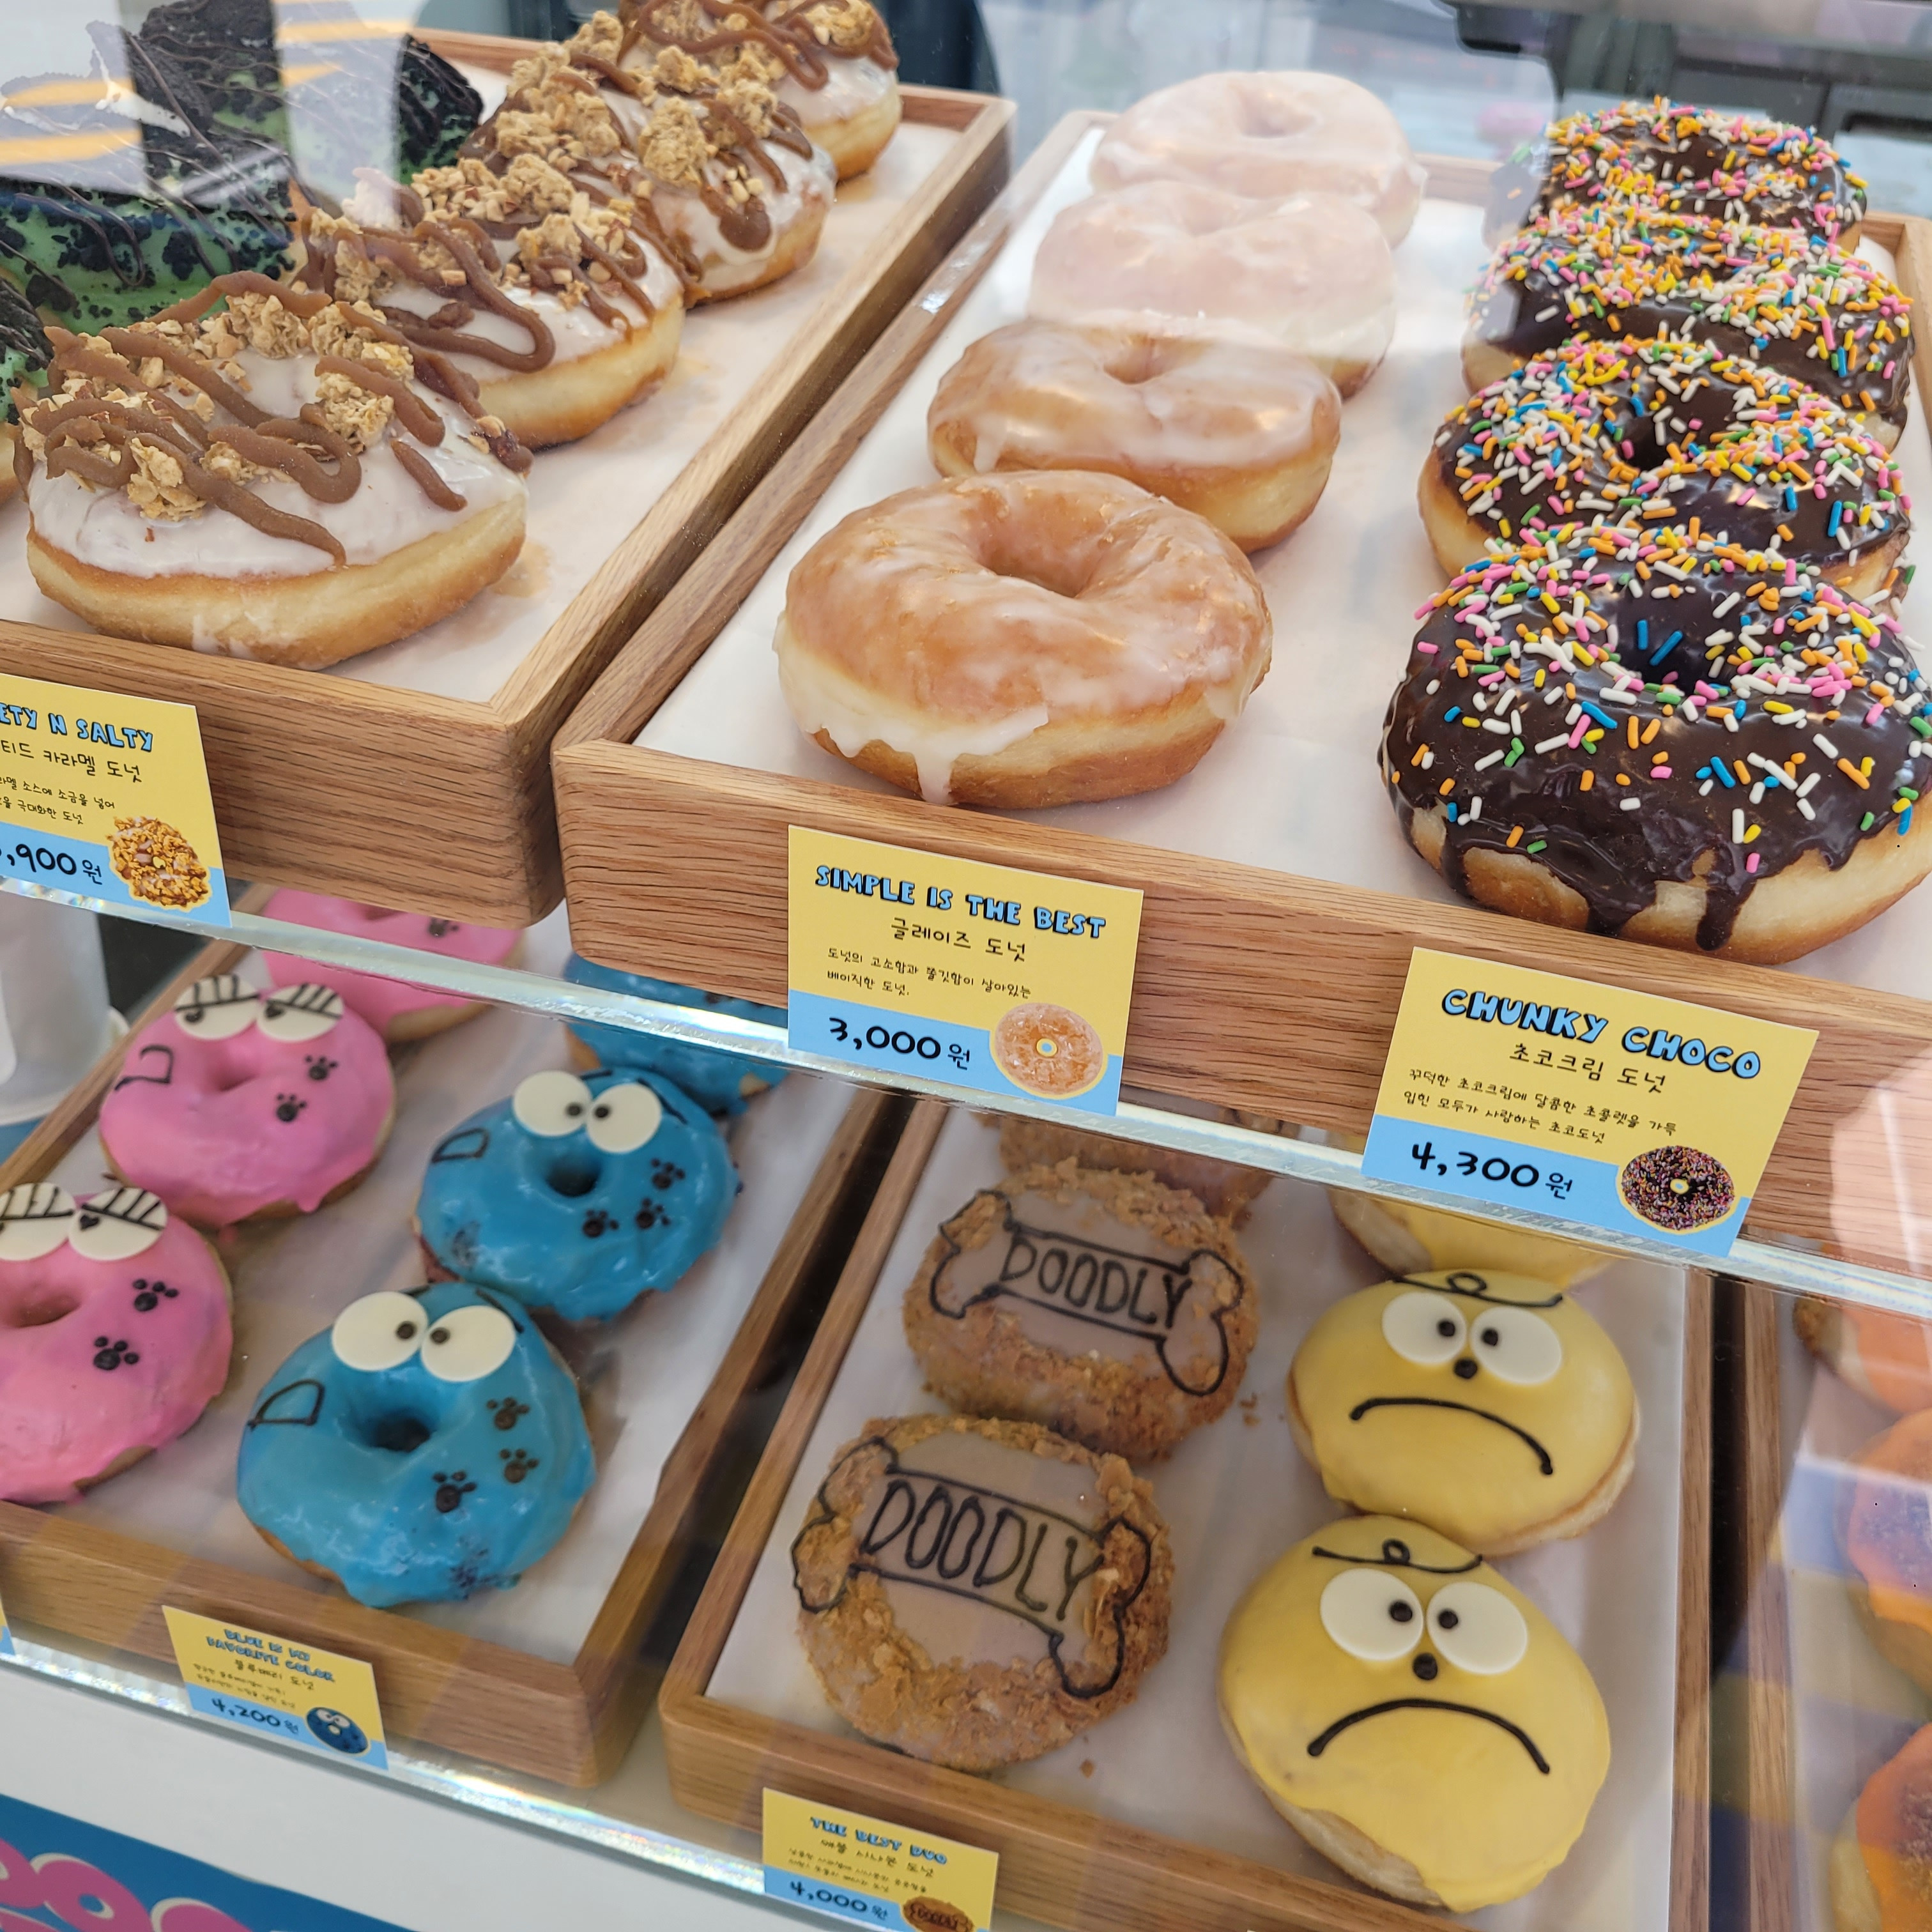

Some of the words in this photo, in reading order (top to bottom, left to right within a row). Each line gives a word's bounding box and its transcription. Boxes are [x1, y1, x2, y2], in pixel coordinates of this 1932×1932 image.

[49, 713, 68, 736] N
[76, 719, 153, 752] SALTY
[0, 740, 34, 758] 티드
[43, 750, 96, 776] 카라멜
[107, 760, 142, 783] 도넛
[18, 799, 56, 819] 극대화한
[63, 811, 84, 825] 도넛
[23, 781, 53, 795] 소스에
[58, 789, 88, 806] 소금을
[94, 797, 115, 809] 넣어
[815, 865, 915, 905] SIMPLE
[926, 886, 953, 910] IS
[965, 894, 1022, 925] THE
[1033, 907, 1107, 939] BEST
[891, 917, 971, 949] 글레이즈
[985, 937, 1025, 962] 도넛
[827, 947, 862, 963] 도넛의
[871, 956, 919, 974] 고소함과
[926, 966, 974, 986] 쫄깃함이
[981, 977, 1031, 999] 살아있는
[827, 970, 875, 990] 베이직한
[1441, 988, 1609, 1043] CHUNKY
[1622, 1026, 1761, 1079] CHOCO
[1509, 1041, 1605, 1081] 초코크림
[1617, 1066, 1666, 1094] 도넛
[1404, 1091, 1430, 1107] 입힌
[1438, 1098, 1478, 1112] 모두가
[1485, 1108, 1540, 1130] 사랑하는
[1549, 1121, 1606, 1144] 초코도넛
[1409, 1068, 1450, 1087] 꾸덕한
[1457, 1077, 1527, 1100] 초코크림에
[1535, 1093, 1576, 1114] 달콤한
[1584, 1105, 1639, 1128] 초콜렛을
[1649, 1120, 1676, 1137] 가득
[999, 1236, 1192, 1330] DOODLY
[860, 1480, 1104, 1621] DOODLY
[206, 1636, 279, 1666] FAVORITE
[285, 1660, 335, 1682] COLOR
[224, 1629, 263, 1648] BLUE
[810, 1816, 847, 1837] THE
[855, 1828, 902, 1851] BEST
[910, 1844, 948, 1866] DUO
